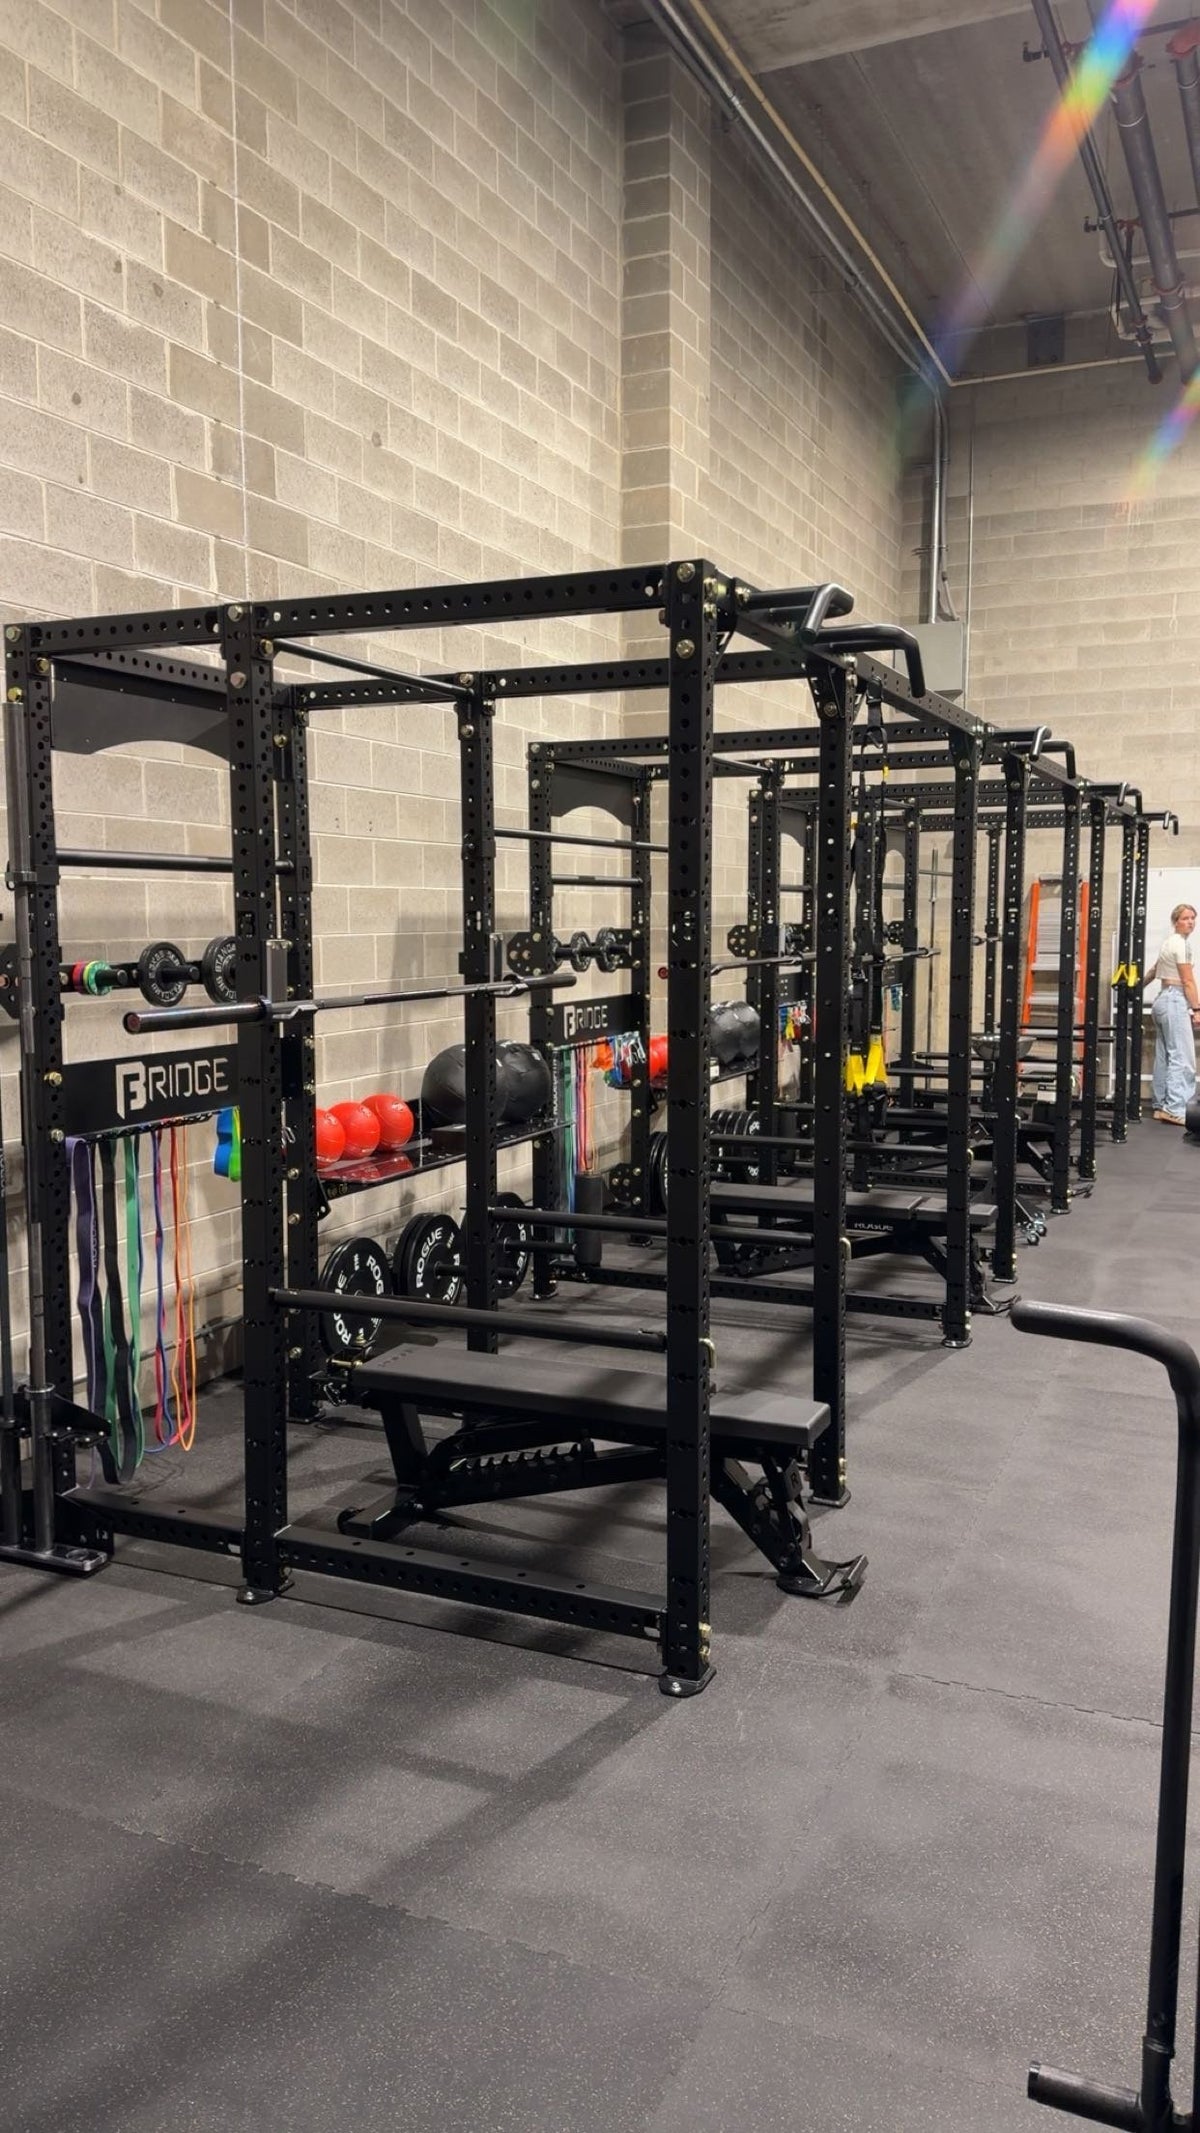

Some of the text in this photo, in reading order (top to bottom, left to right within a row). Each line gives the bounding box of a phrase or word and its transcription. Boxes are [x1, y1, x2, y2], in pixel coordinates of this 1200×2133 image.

[563, 1004, 608, 1040] BRIDGE
[115, 1057, 229, 1120] BRIDGE
[415, 1227, 444, 1289] ROGUE
[333, 1270, 353, 1346] ROE
